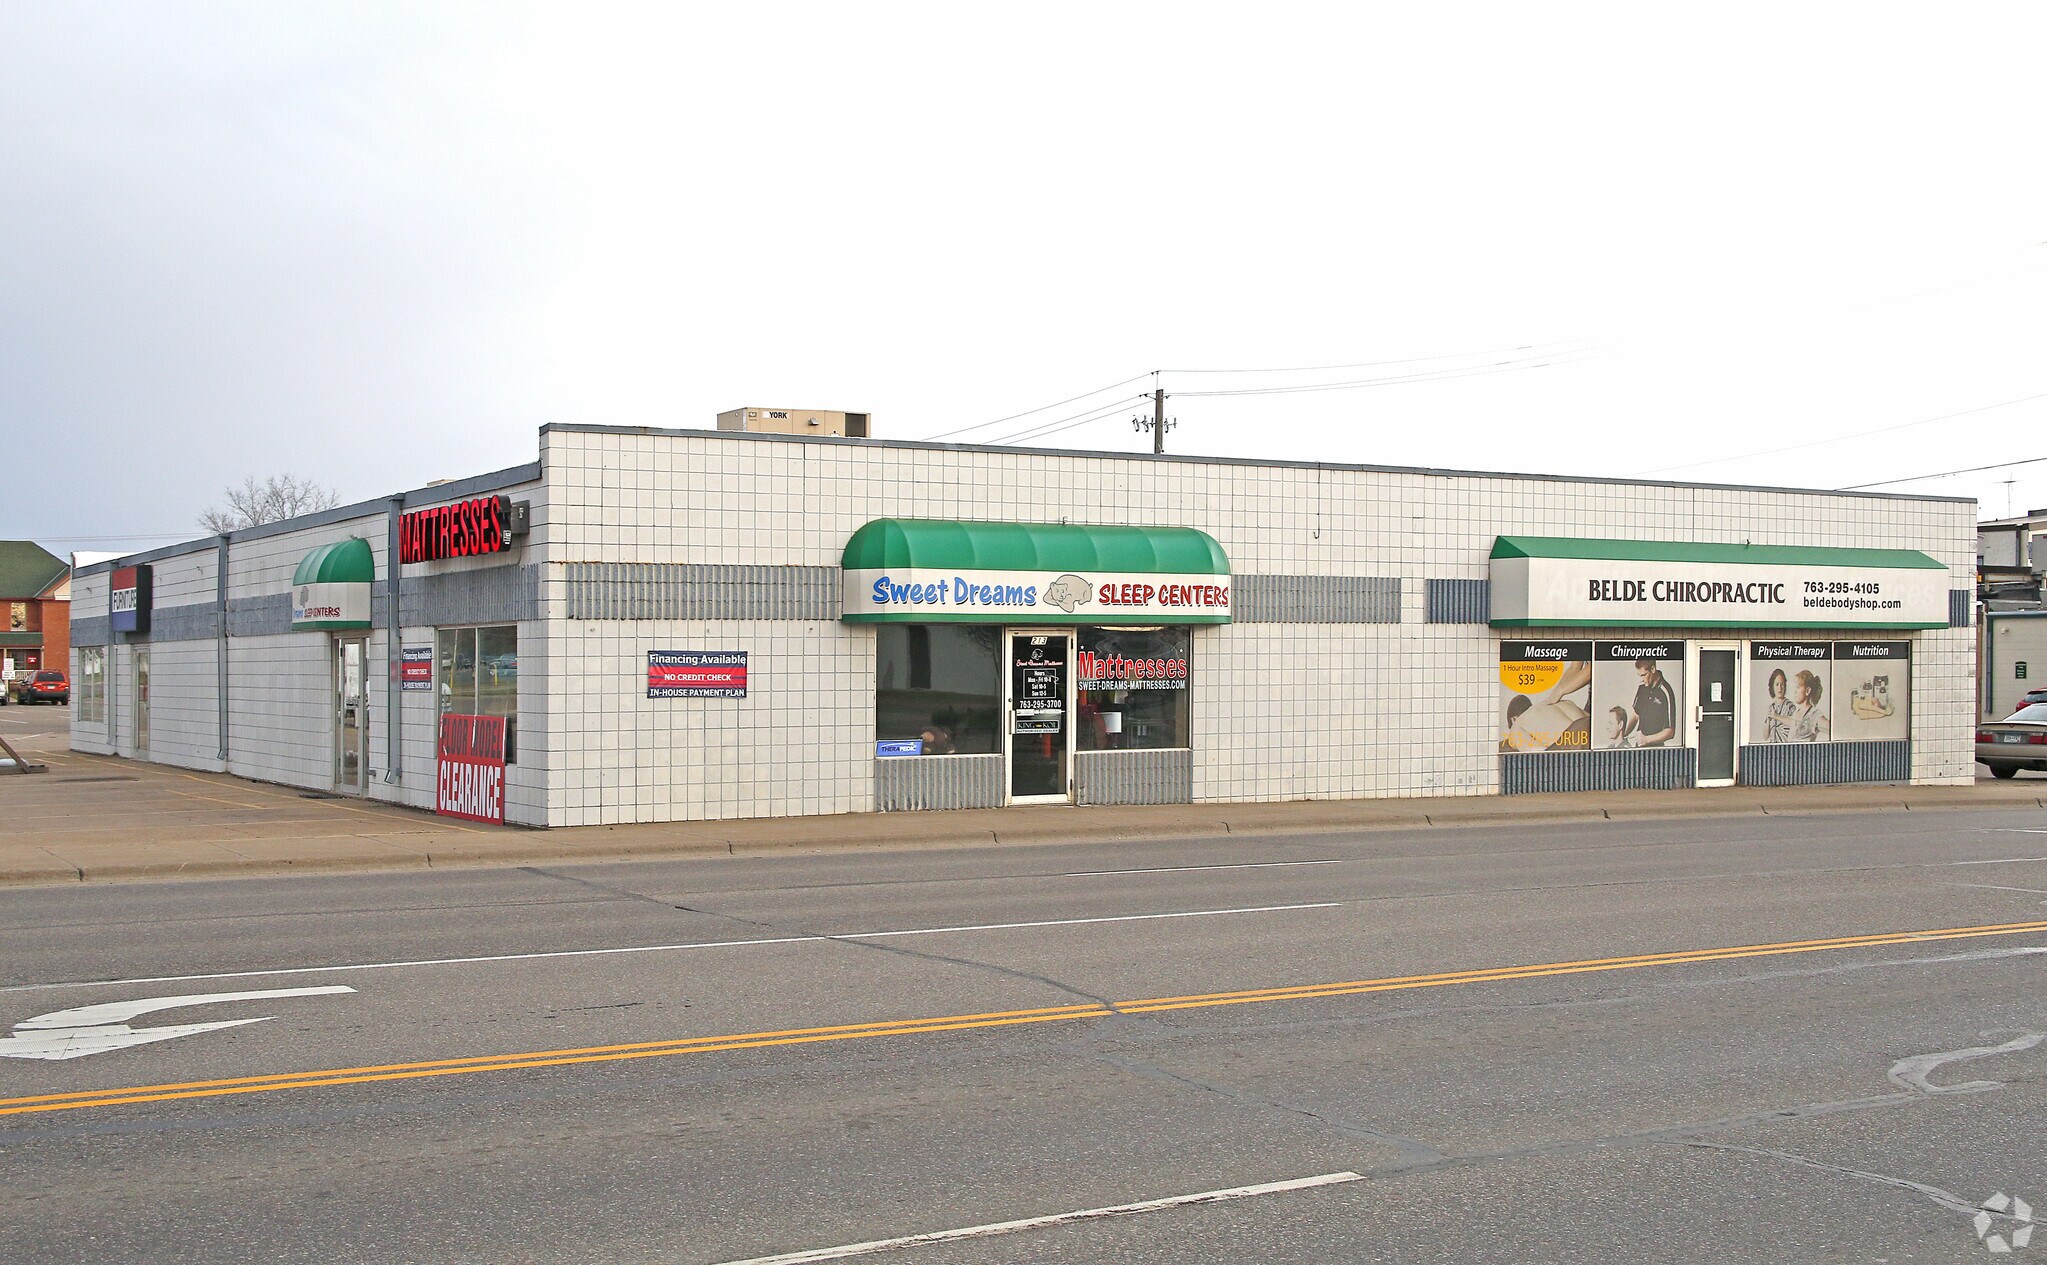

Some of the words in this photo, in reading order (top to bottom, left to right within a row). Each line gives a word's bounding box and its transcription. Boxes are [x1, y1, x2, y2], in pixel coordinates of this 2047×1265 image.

[769, 411, 787, 419] YORK
[399, 494, 501, 565] MATTRESSES
[872, 576, 948, 606] Sweet
[954, 577, 1037, 607] Dreams
[1588, 579, 1647, 602] BELDE
[1652, 581, 1786, 604] CHIROPRACTIC
[1803, 581, 1880, 595] 763-295-4105
[1099, 583, 1155, 607] SLEEP
[1158, 585, 1229, 608] CENTERS
[1803, 596, 1902, 611] beldebodyshop.com
[1031, 636, 1048, 645] 213
[1524, 645, 1568, 660] Massage
[1611, 645, 1668, 659] Chiropractic
[1757, 645, 1792, 658] Physical
[1793, 646, 1826, 658] Therapy
[1852, 645, 1889, 656] Nutrition
[649, 653, 698, 666] Financing
[700, 654, 747, 665] Available
[1078, 651, 1187, 680] Mattresses
[1521, 664, 1535, 672] Intro
[1535, 664, 1558, 673] Massage
[664, 673, 676, 681] NO
[677, 673, 706, 681] CREDIT
[1518, 673, 1536, 686] $39
[1078, 680, 1186, 691] SWEET-DREAMS-MATTRESSES.COM
[649, 688, 688, 697] IN-HOUSE
[689, 689, 724, 697] PAYMENT
[725, 689, 745, 697] PLAN
[1019, 699, 1062, 709] 763-295-3700
[440, 759, 501, 819] CLEARANCE
